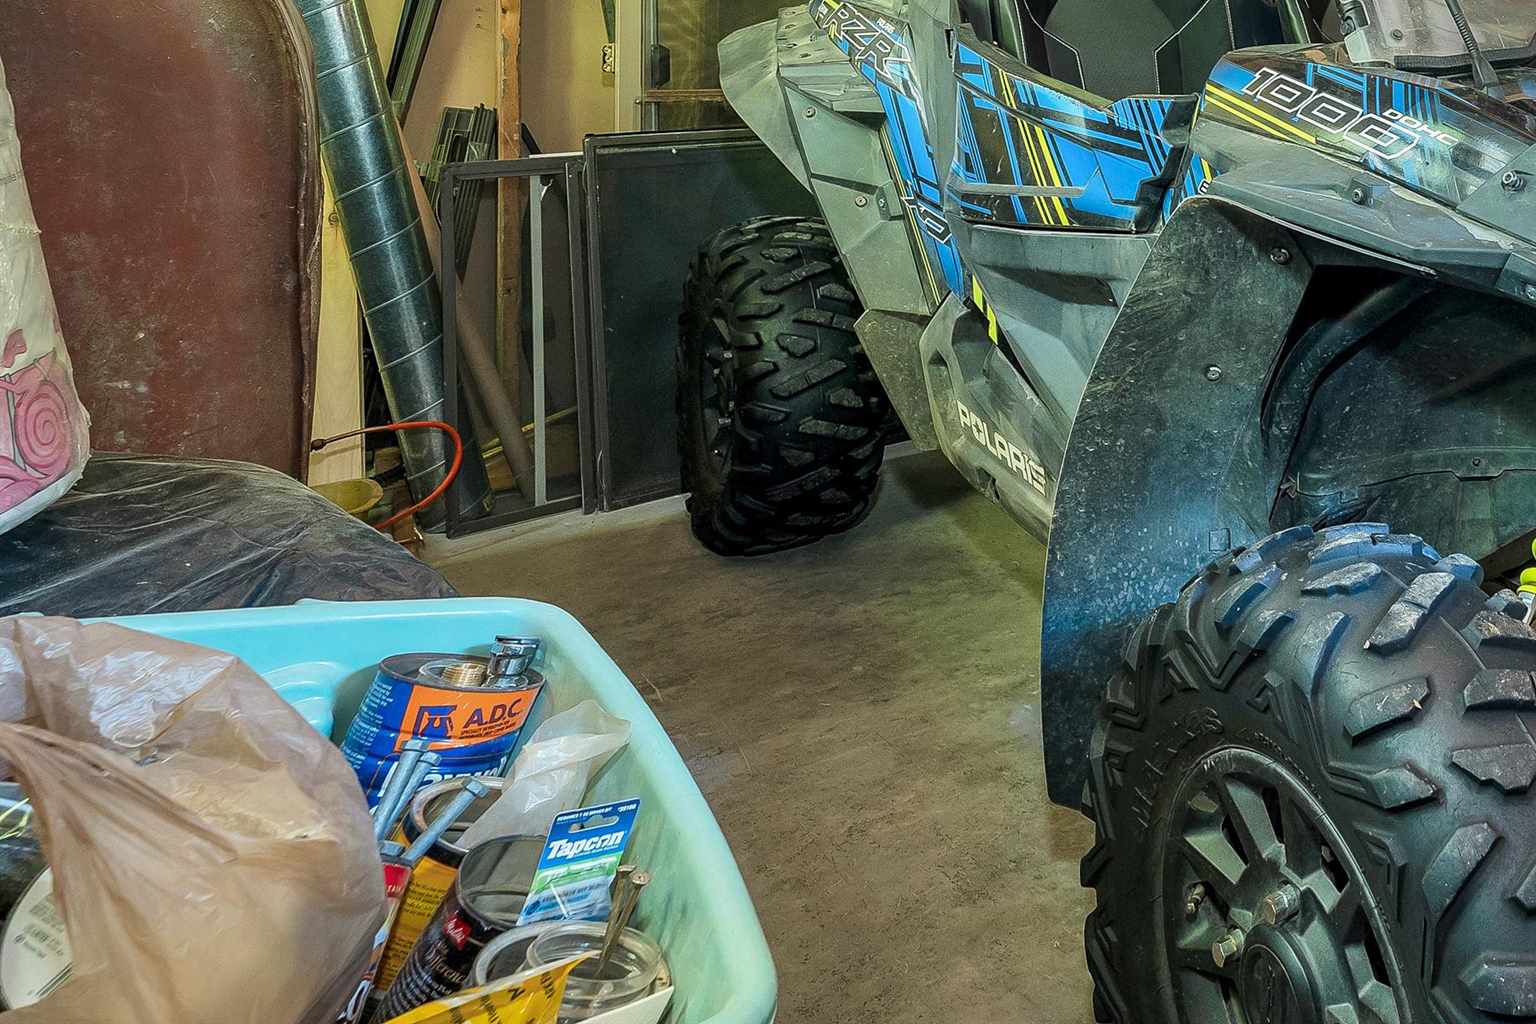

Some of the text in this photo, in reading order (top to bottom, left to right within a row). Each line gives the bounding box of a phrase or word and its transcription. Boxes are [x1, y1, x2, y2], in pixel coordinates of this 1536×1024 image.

[822, 1, 912, 86] RZR
[1242, 66, 1420, 160] 1000
[957, 400, 1046, 496] POLARIS
[547, 831, 625, 860] Tapcon
